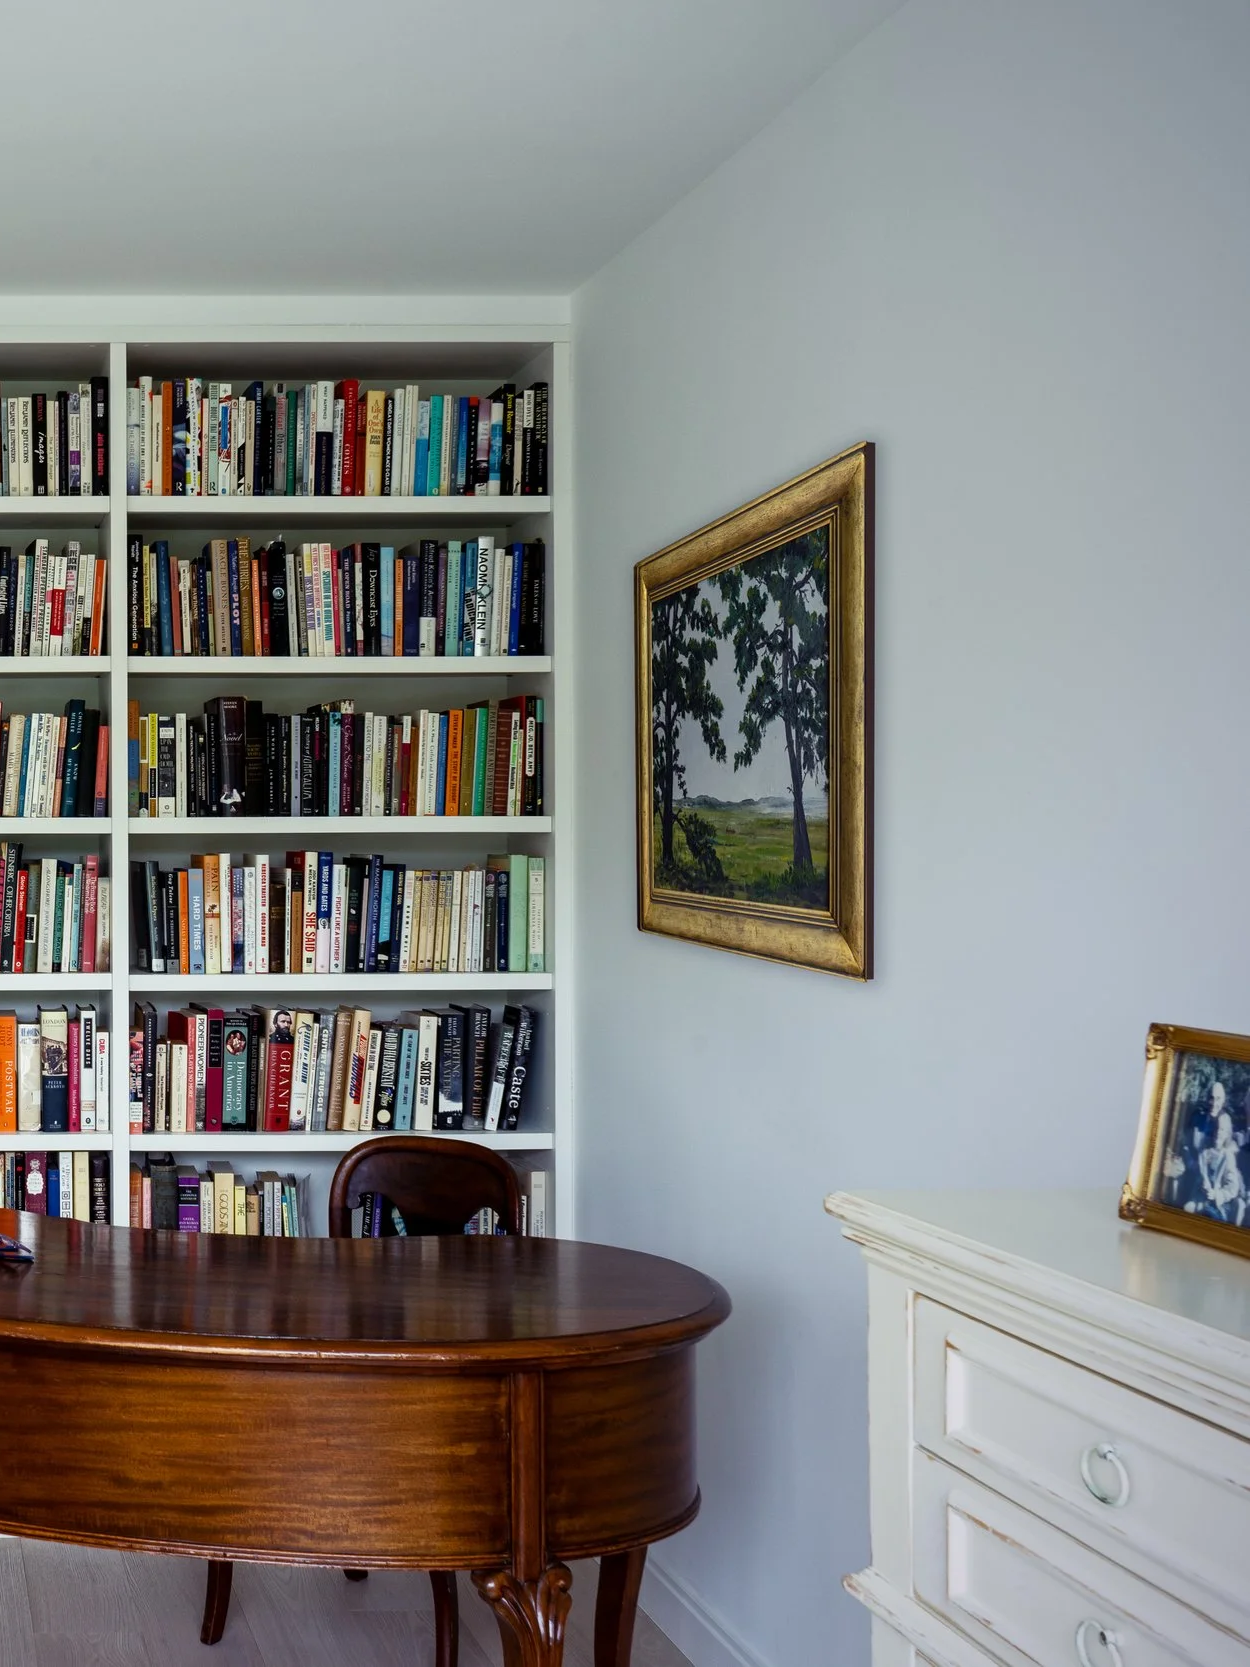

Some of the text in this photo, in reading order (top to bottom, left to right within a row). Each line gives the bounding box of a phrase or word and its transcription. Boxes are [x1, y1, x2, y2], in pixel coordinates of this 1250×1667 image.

[506, 394, 514, 434] Jean Renoir
[276, 433, 285, 454] Others
[239, 540, 249, 591] THE FURIES
[368, 570, 378, 627] Downcast Eyes
[476, 548, 489, 630] NAOMI KLEIN
[463, 622, 473, 642] KING
[4, 849, 16, 937] STEINBERG OTHER CRITERIA
[321, 866, 329, 882] YARDS
[321, 883, 329, 894] AND
[193, 924, 201, 950] TIMES
[304, 912, 316, 952] SHE SAID
[196, 1018, 205, 1083] PIONEER WOMEN
[320, 1030, 329, 1064] CENTURY
[384, 1032, 398, 1049] DAVID
[452, 1037, 461, 1077] PARTING
[474, 1040, 485, 1077] PILLAR
[516, 1022, 527, 1056] Wilkerson
[523, 1030, 533, 1050] Isabel
[278, 1051, 291, 1111] GRANT
[335, 1036, 346, 1090] WOMAN'S HOUR
[419, 1061, 432, 1086] SIXTIES
[443, 1038, 452, 1096] THE WATERS
[5, 1060, 13, 1113] POSTWAR
[226, 1062, 235, 1111] in America
[235, 1062, 246, 1111] Democracy
[317, 1072, 326, 1113] STRUGGLE
[472, 1079, 482, 1093] OF
[508, 1066, 527, 1109] Caste
[219, 1194, 228, 1219] GODS
[237, 1203, 245, 1216] THE
